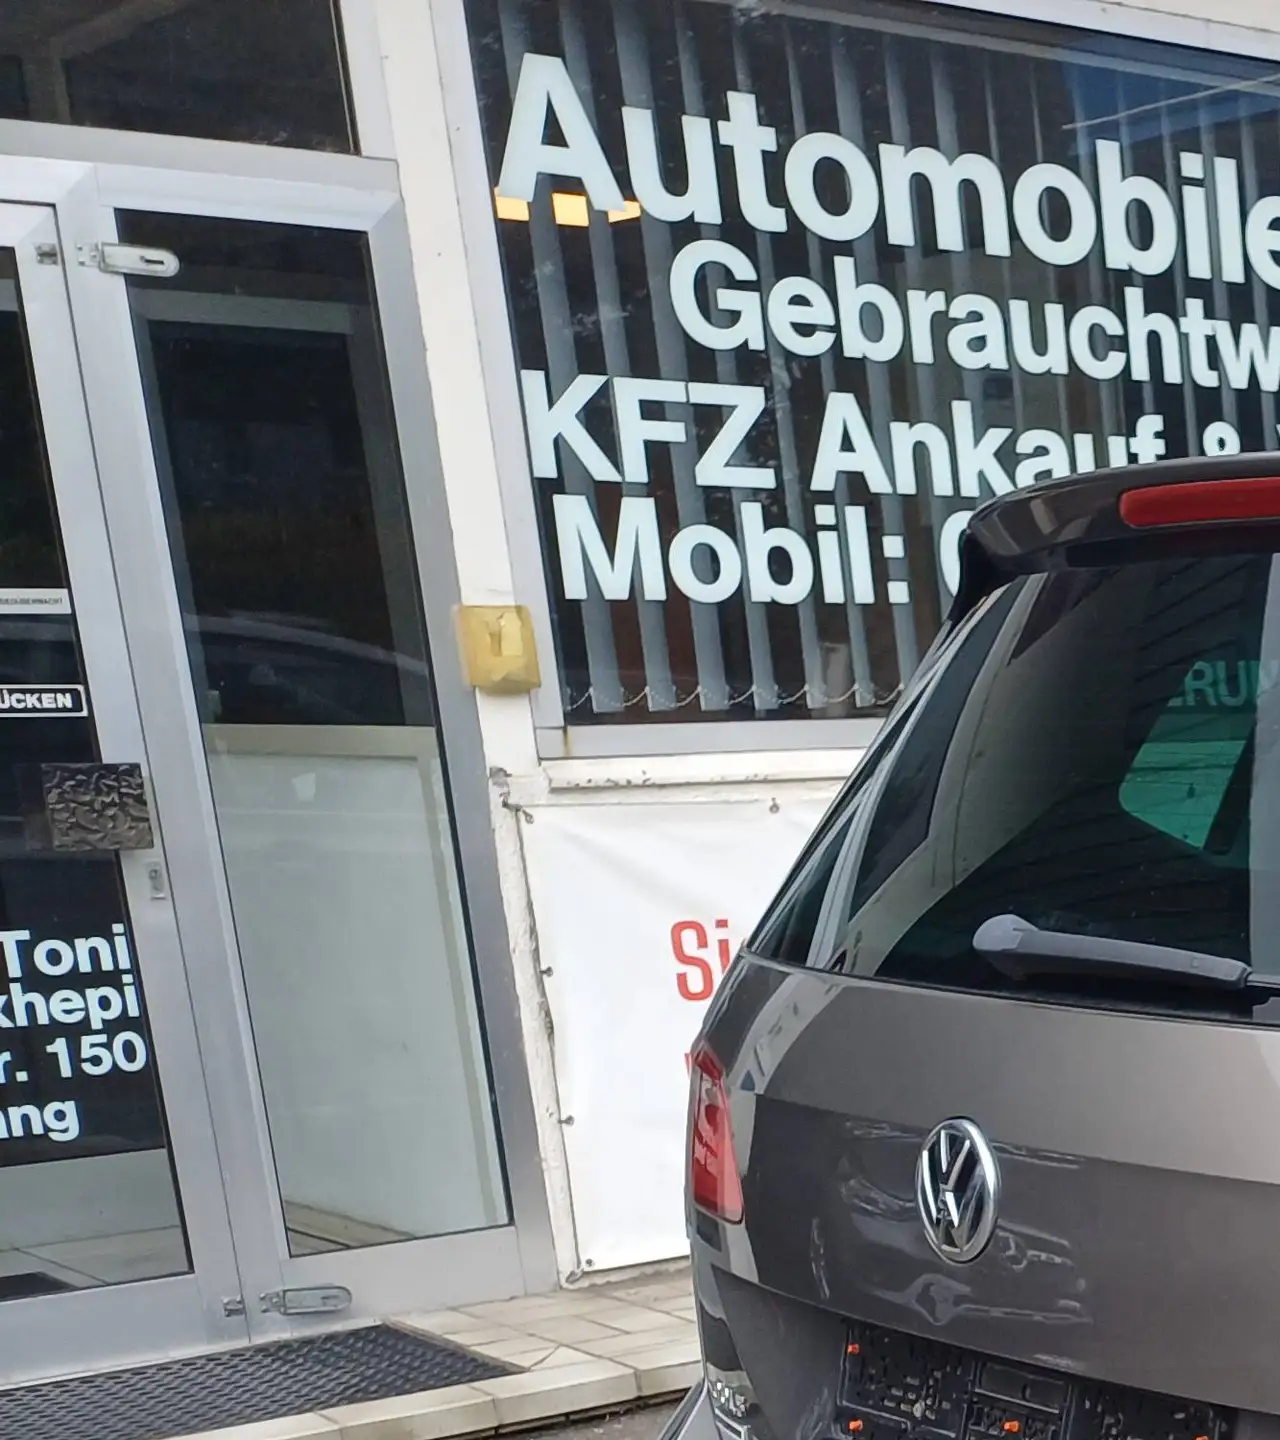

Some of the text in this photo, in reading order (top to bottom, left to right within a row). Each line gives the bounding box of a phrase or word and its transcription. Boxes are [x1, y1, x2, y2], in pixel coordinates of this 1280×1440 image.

[520, 369, 1167, 498] KFZ Ankauf
[552, 494, 909, 605] Mobil:
[0, 923, 131, 978] Toni
[46, 1030, 147, 1078] 150
[0, 1100, 80, 1142] ng
